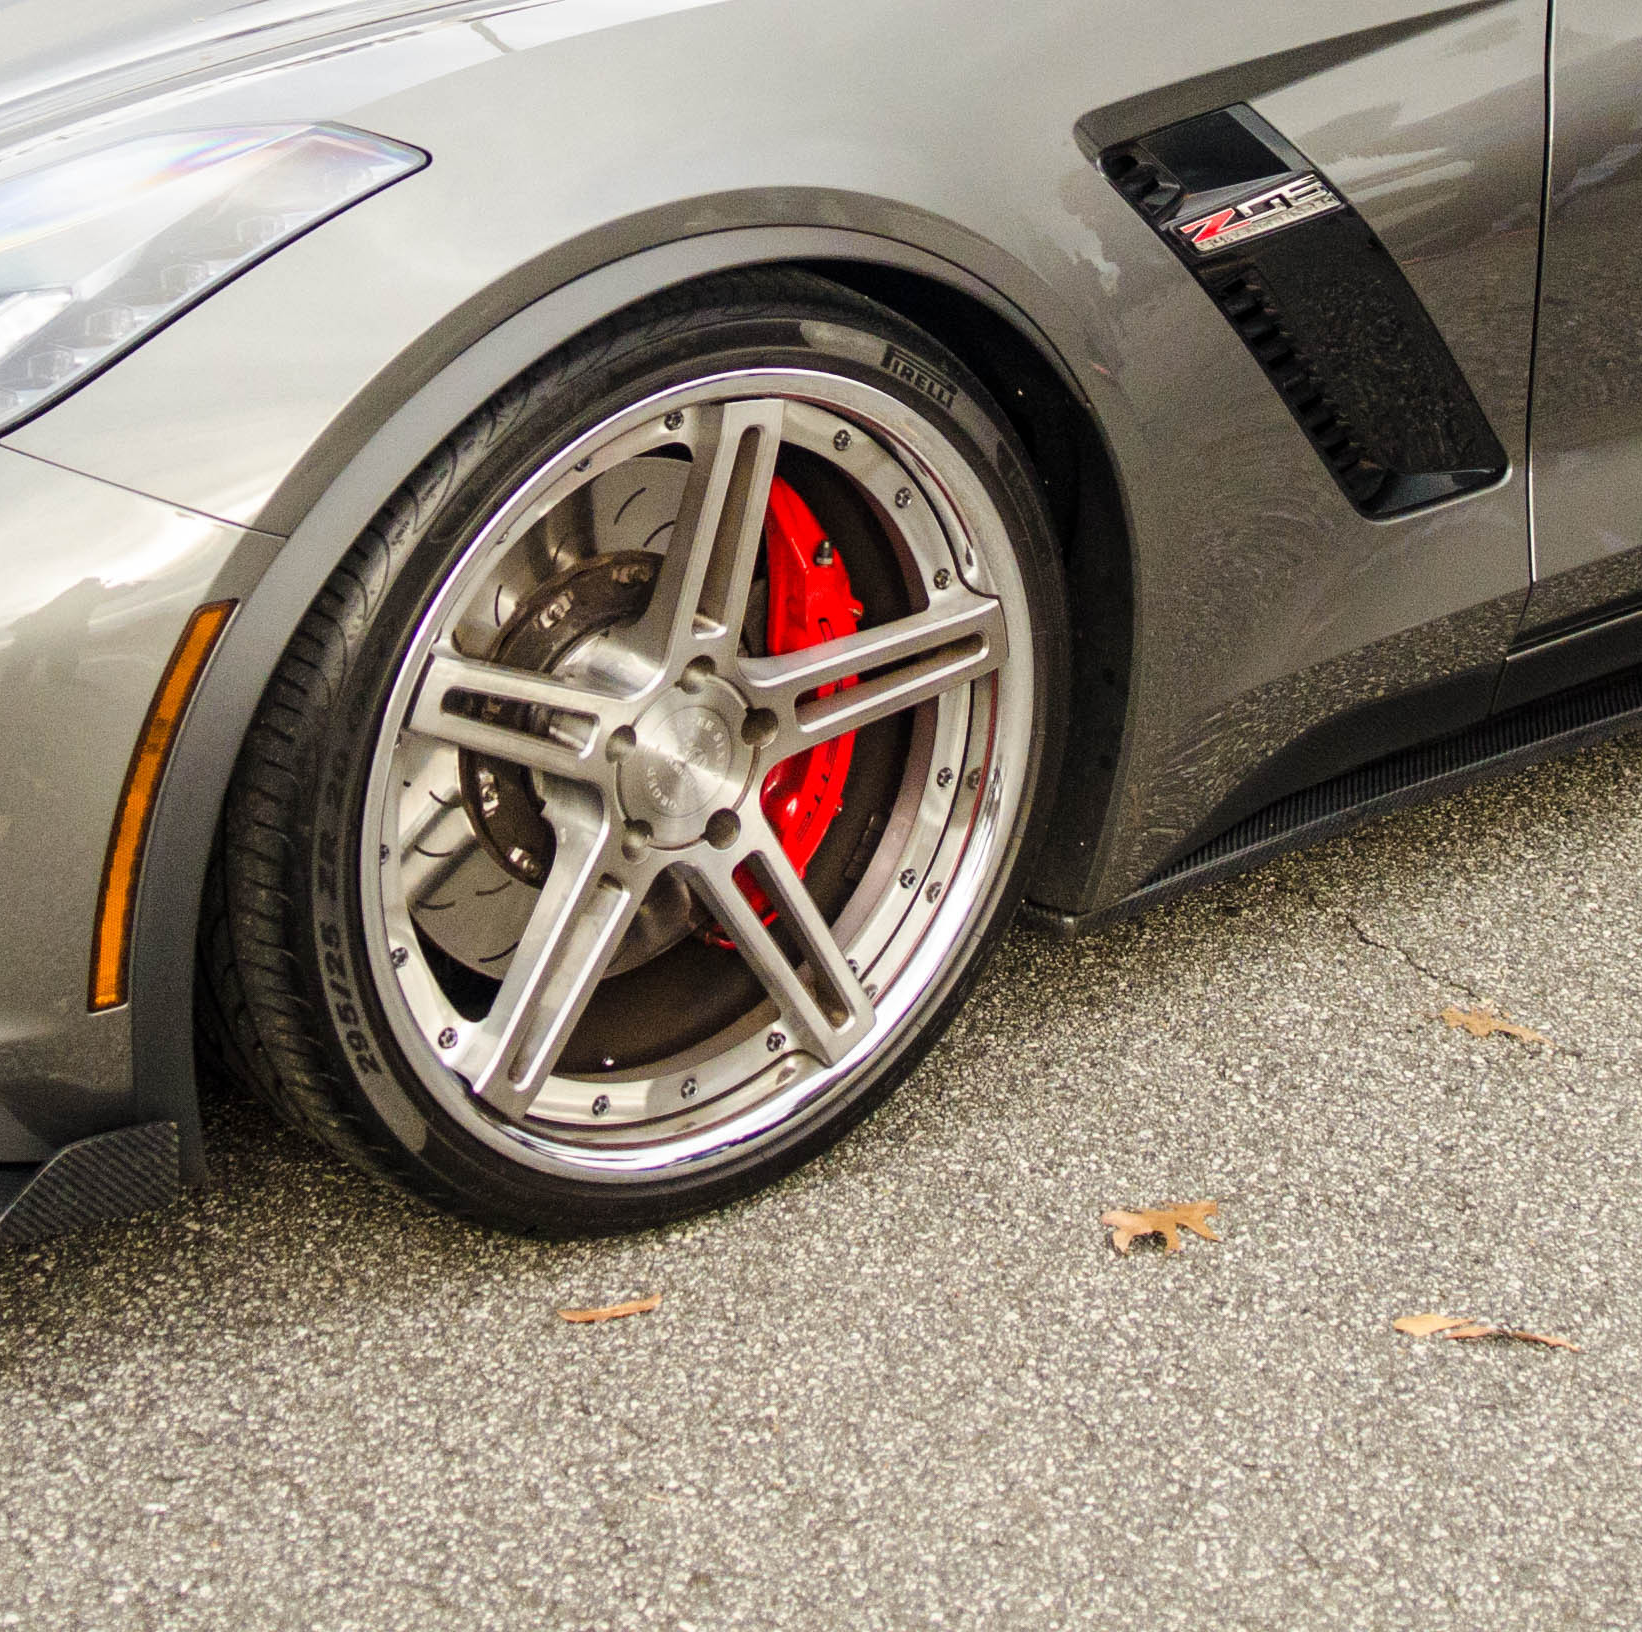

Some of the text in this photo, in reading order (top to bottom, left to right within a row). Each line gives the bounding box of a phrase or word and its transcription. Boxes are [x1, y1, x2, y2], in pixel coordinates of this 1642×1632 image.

[1180, 174, 1329, 243] Z06
[881, 344, 957, 409] PIRELLI
[320, 922, 382, 1075] 295/25
